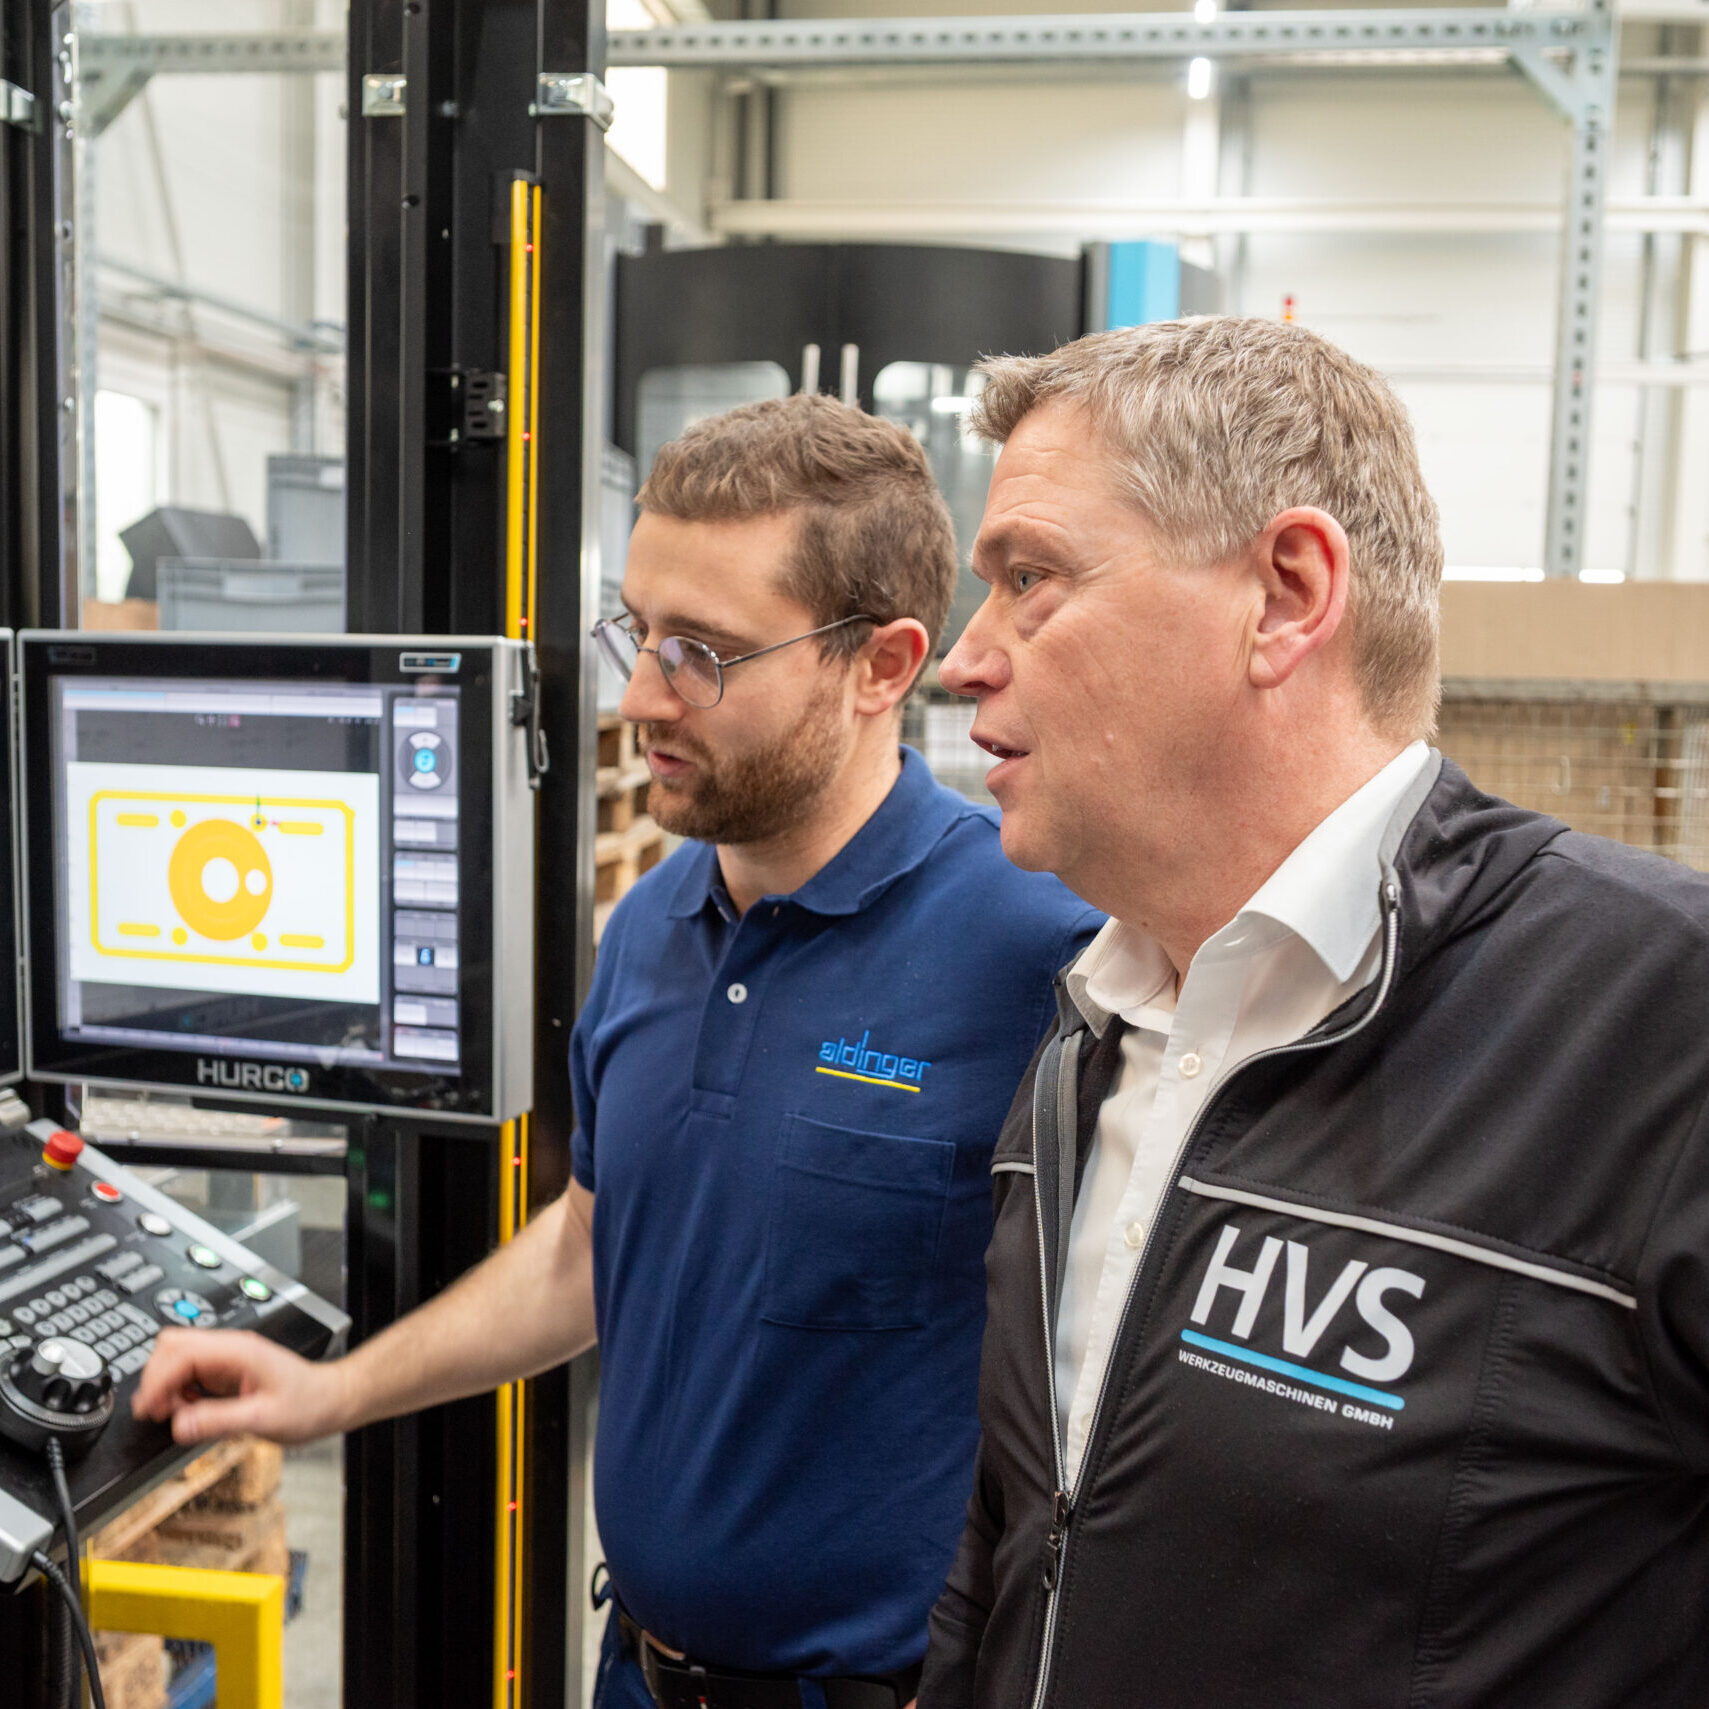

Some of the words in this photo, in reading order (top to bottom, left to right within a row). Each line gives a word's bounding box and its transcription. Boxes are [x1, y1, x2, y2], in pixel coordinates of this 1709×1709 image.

[197, 1058, 309, 1092] HURCO
[819, 1029, 932, 1081] aldinger
[1190, 1224, 1426, 1382] HVS
[1178, 1349, 1337, 1413] WERKZEUGMASCHINEN
[1341, 1404, 1394, 1430] GMBH
